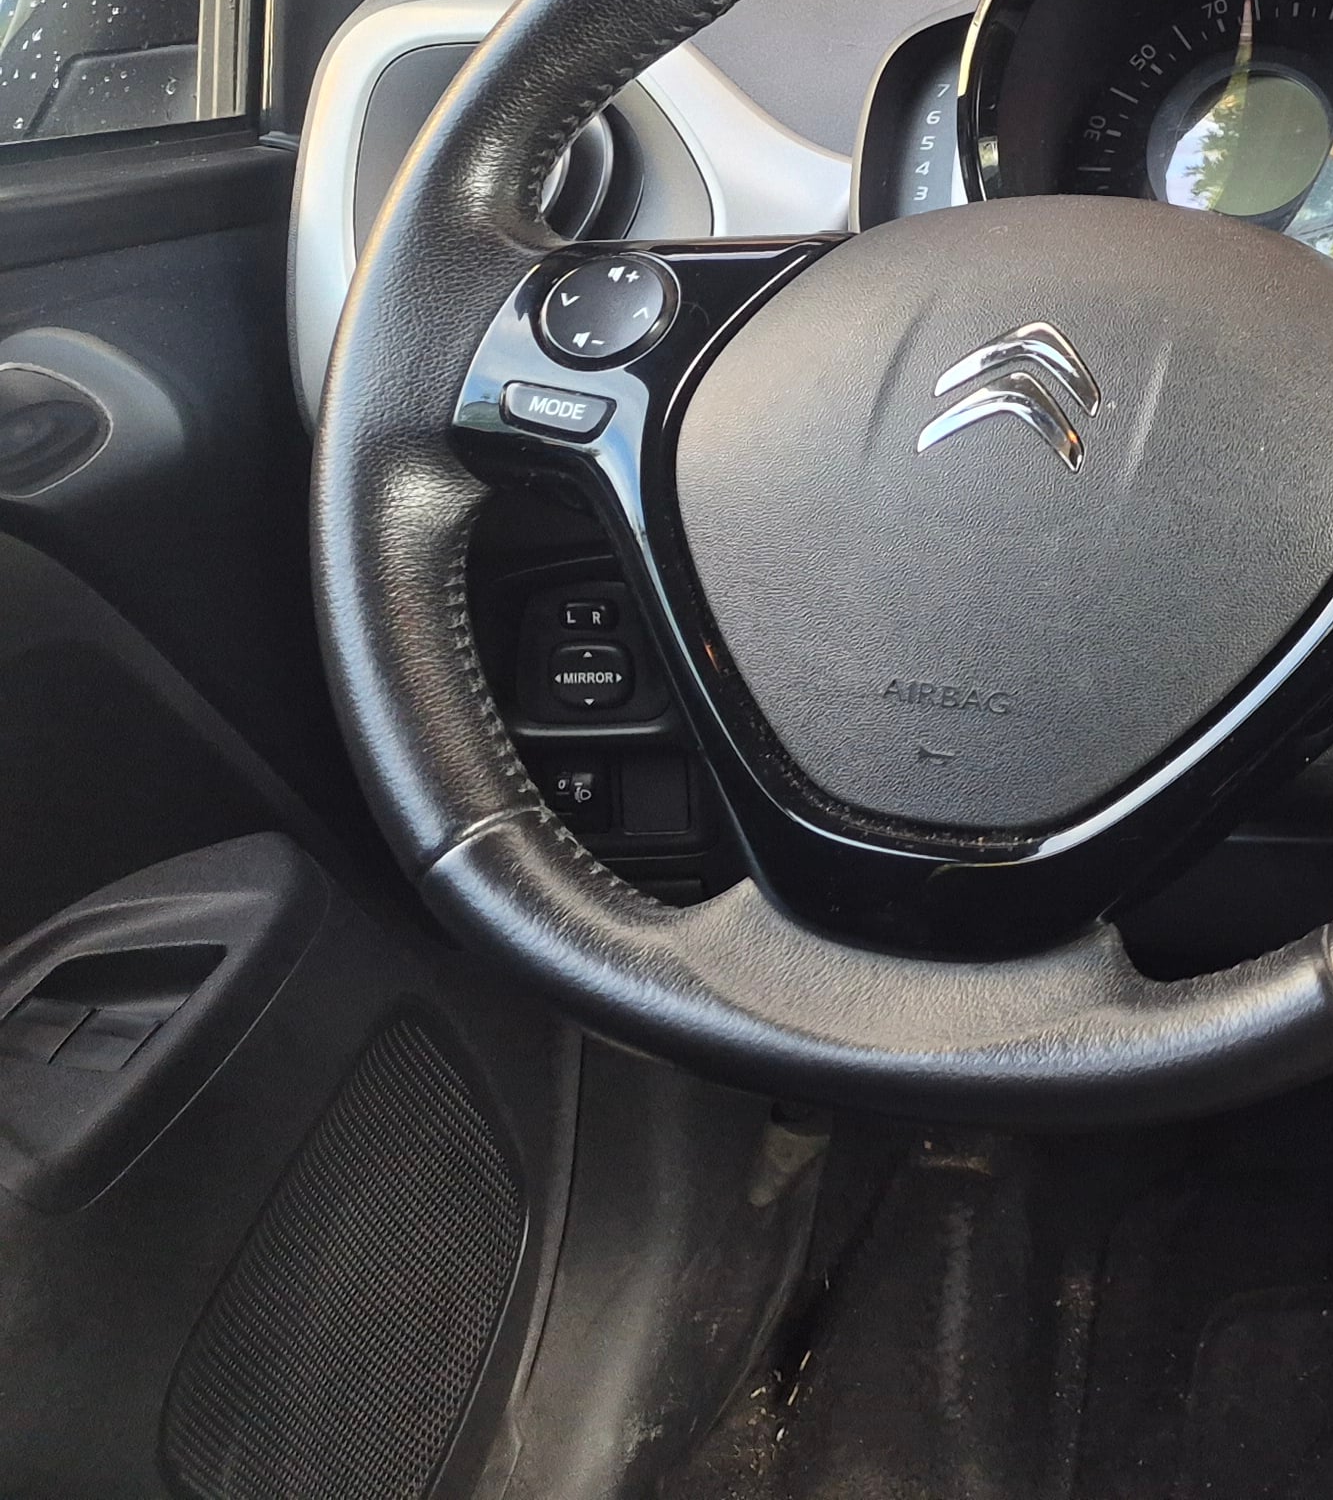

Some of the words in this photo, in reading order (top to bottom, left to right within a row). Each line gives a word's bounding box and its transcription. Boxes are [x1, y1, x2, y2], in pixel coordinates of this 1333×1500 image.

[1129, 44, 1156, 70] 50
[937, 84, 950, 98] 7
[926, 110, 942, 125] 6
[1084, 115, 1106, 142] 30
[920, 136, 936, 150] 5
[915, 161, 930, 175] 4
[913, 186, 929, 201] 3
[529, 395, 587, 421] MODE
[566, 611, 576, 624] L
[592, 611, 601, 625] R
[563, 671, 614, 685] MIRROR
[883, 679, 1011, 714] AIRBAG
